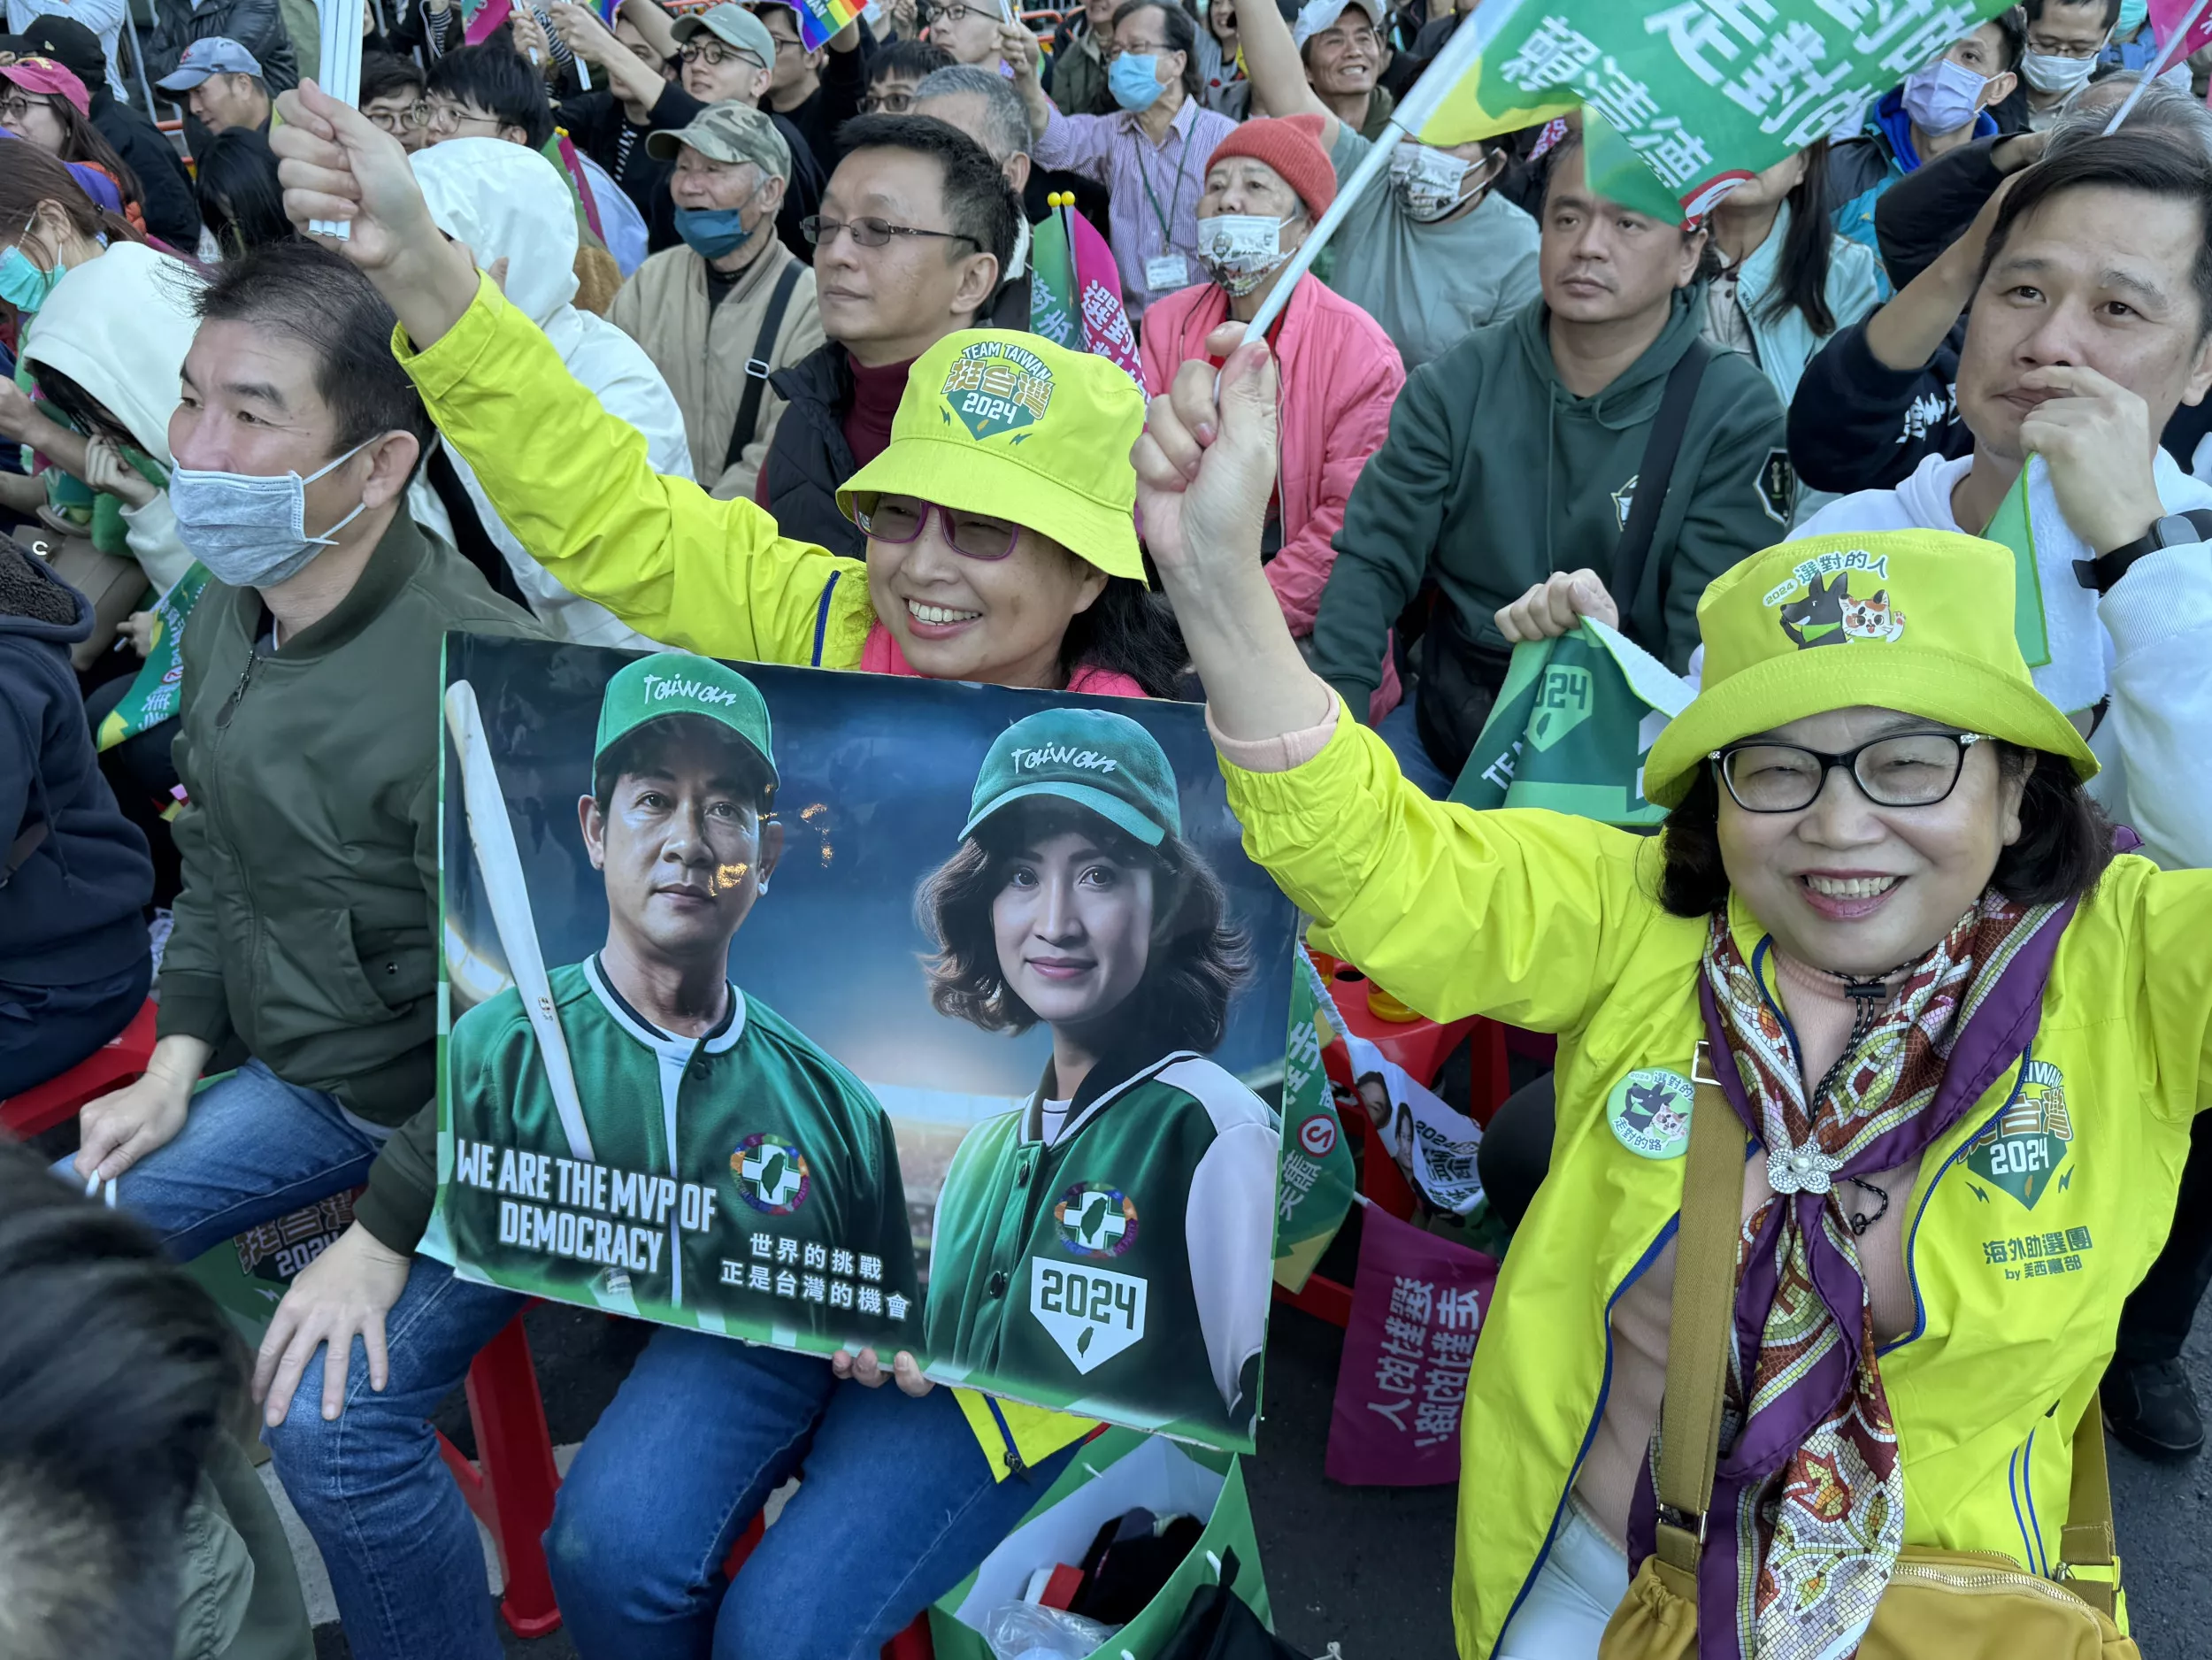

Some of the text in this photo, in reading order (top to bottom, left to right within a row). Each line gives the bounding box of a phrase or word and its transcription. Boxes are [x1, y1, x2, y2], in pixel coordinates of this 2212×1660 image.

[962, 342, 1053, 380] TEAM TAIWAN
[962, 392, 1018, 424] 2024
[1793, 550, 1887, 584] 選對的人
[1764, 581, 1794, 604] 2024
[643, 673, 736, 706] Taiwan
[1011, 742, 1118, 774] Taiwan
[1653, 1071, 1694, 1102] 選對的
[2024, 1061, 2063, 1087] IWAN
[1614, 1118, 1662, 1151] 走對的路
[1990, 1137, 2049, 1175] 2024
[457, 1139, 494, 1188] WE
[497, 1149, 550, 1199] ARE
[556, 1157, 606, 1210] THE
[611, 1169, 676, 1223] MVP
[680, 1184, 717, 1232] OF
[274, 1231, 340, 1278] 202
[500, 1200, 664, 1273] DEMOCRACY
[1982, 1226, 2093, 1264] 海外助選團
[750, 1232, 883, 1281] 世界的挑戰
[2004, 1268, 2021, 1280] by
[720, 1259, 911, 1320] 正是台灣的機會
[1041, 1268, 1137, 1330] 2024
